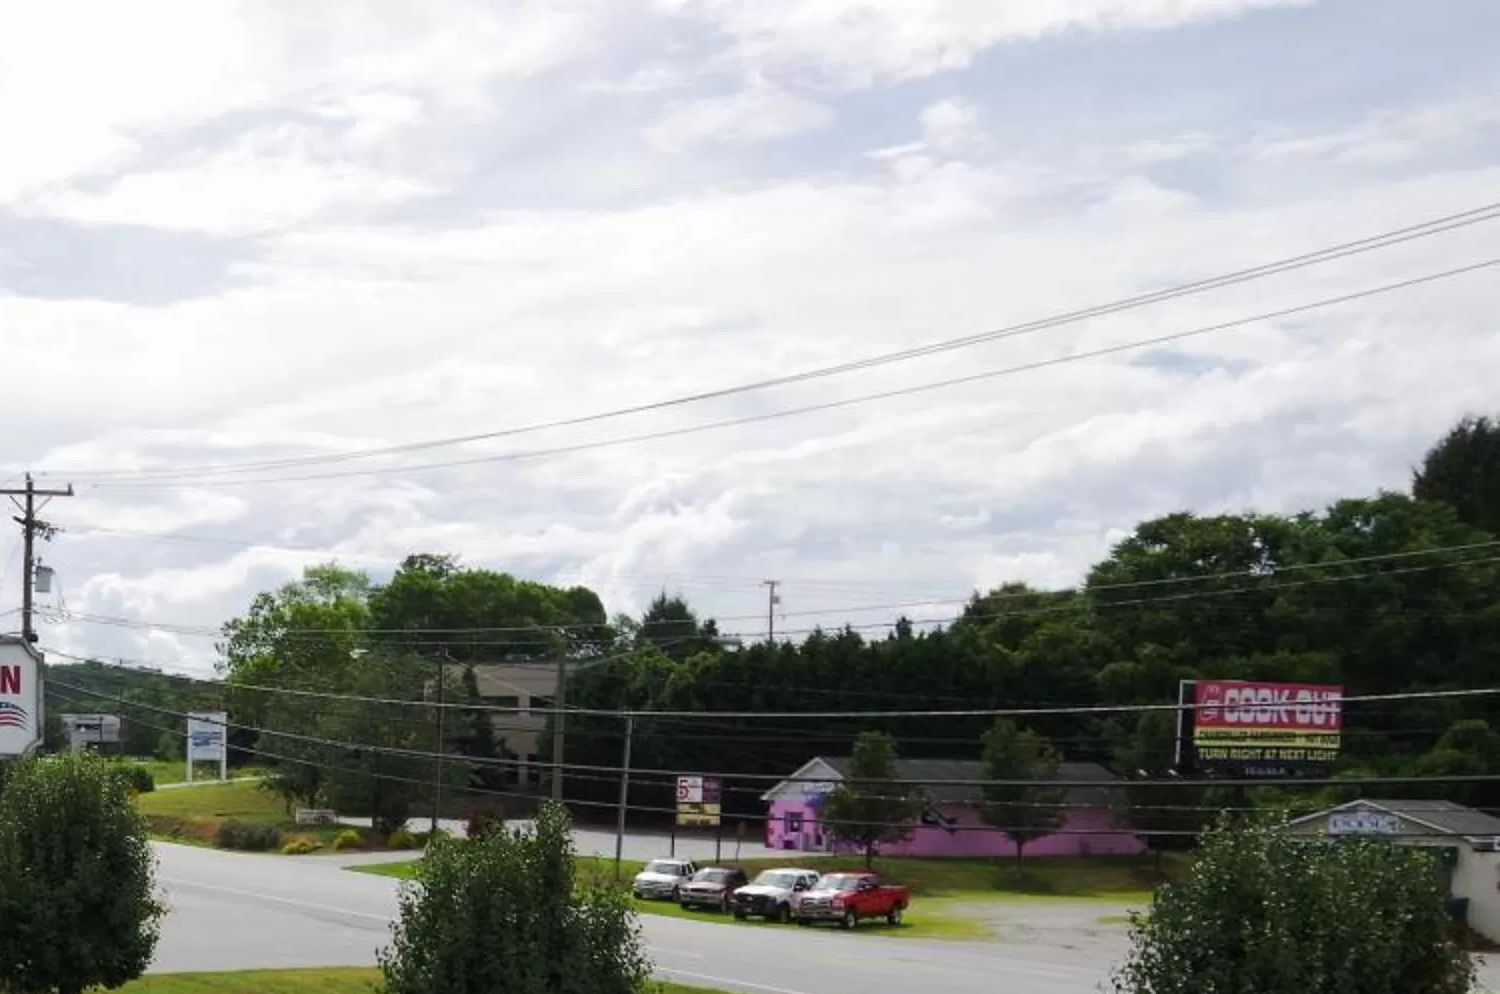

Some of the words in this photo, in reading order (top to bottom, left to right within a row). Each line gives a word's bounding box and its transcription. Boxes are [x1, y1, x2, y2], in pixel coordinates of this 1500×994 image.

[1224, 688, 1289, 723] COOK
[1295, 689, 1342, 726] OUT
[1198, 747, 1227, 760] TURN
[1230, 747, 1262, 760] RIGHT
[1264, 748, 1277, 760] AT
[1279, 748, 1305, 761] NEXT
[1307, 749, 1338, 761] LIGHT
